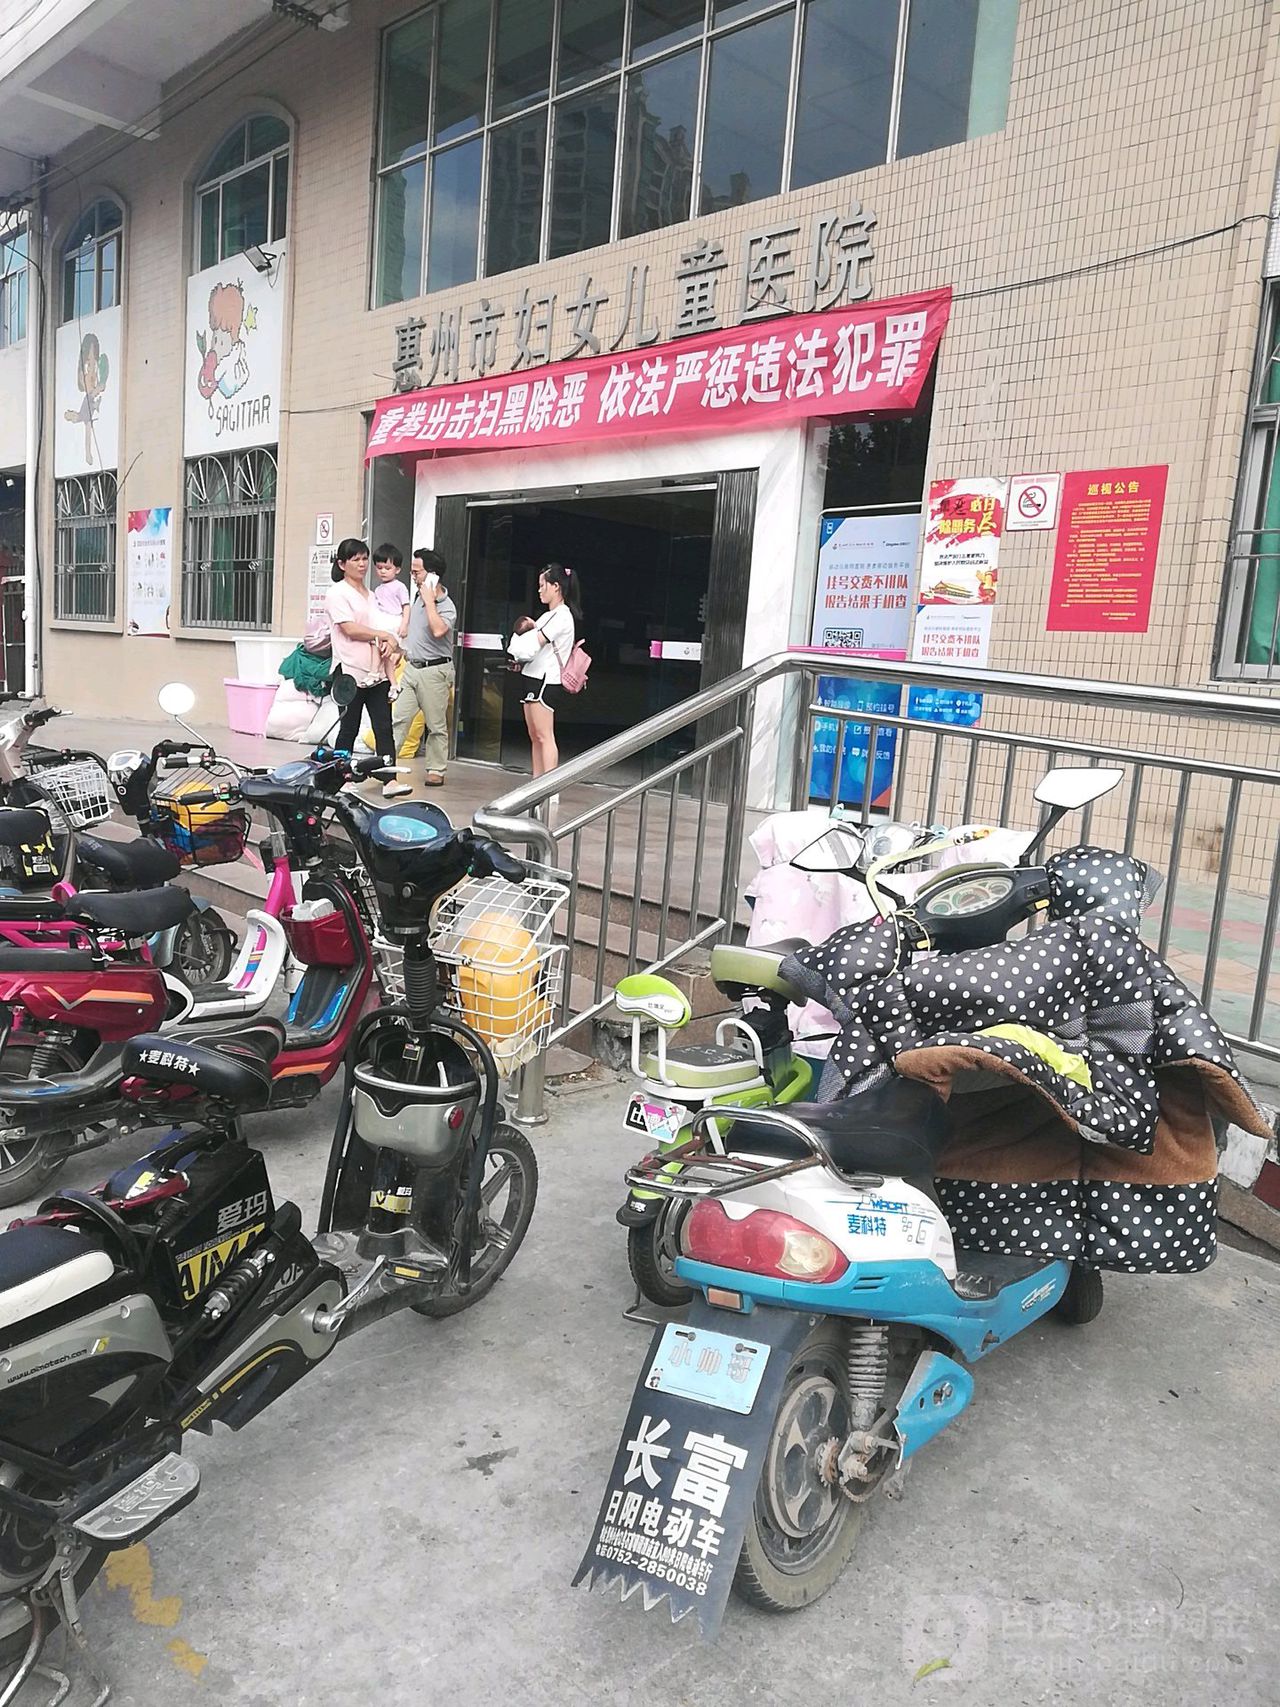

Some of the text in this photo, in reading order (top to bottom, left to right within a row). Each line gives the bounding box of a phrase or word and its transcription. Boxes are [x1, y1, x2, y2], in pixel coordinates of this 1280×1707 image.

[391, 200, 878, 394] 惠州市妇女儿童医院
[368, 311, 928, 448] 重拳出击扫黑除恶 依法严惩违法犯罪
[215, 394, 270, 437] SAGITTAR
[1087, 481, 1140, 496] 巡视公告
[825, 594, 907, 609] 报告结果手机查
[827, 574, 908, 590] 挂号交费不排队
[147, 1050, 189, 1073] 麦科特
[216, 1190, 267, 1235] 爱玛
[846, 1214, 887, 1237] 麦科特
[624, 1415, 749, 1518] 长富
[604, 1490, 726, 1560] 日阳电动车
